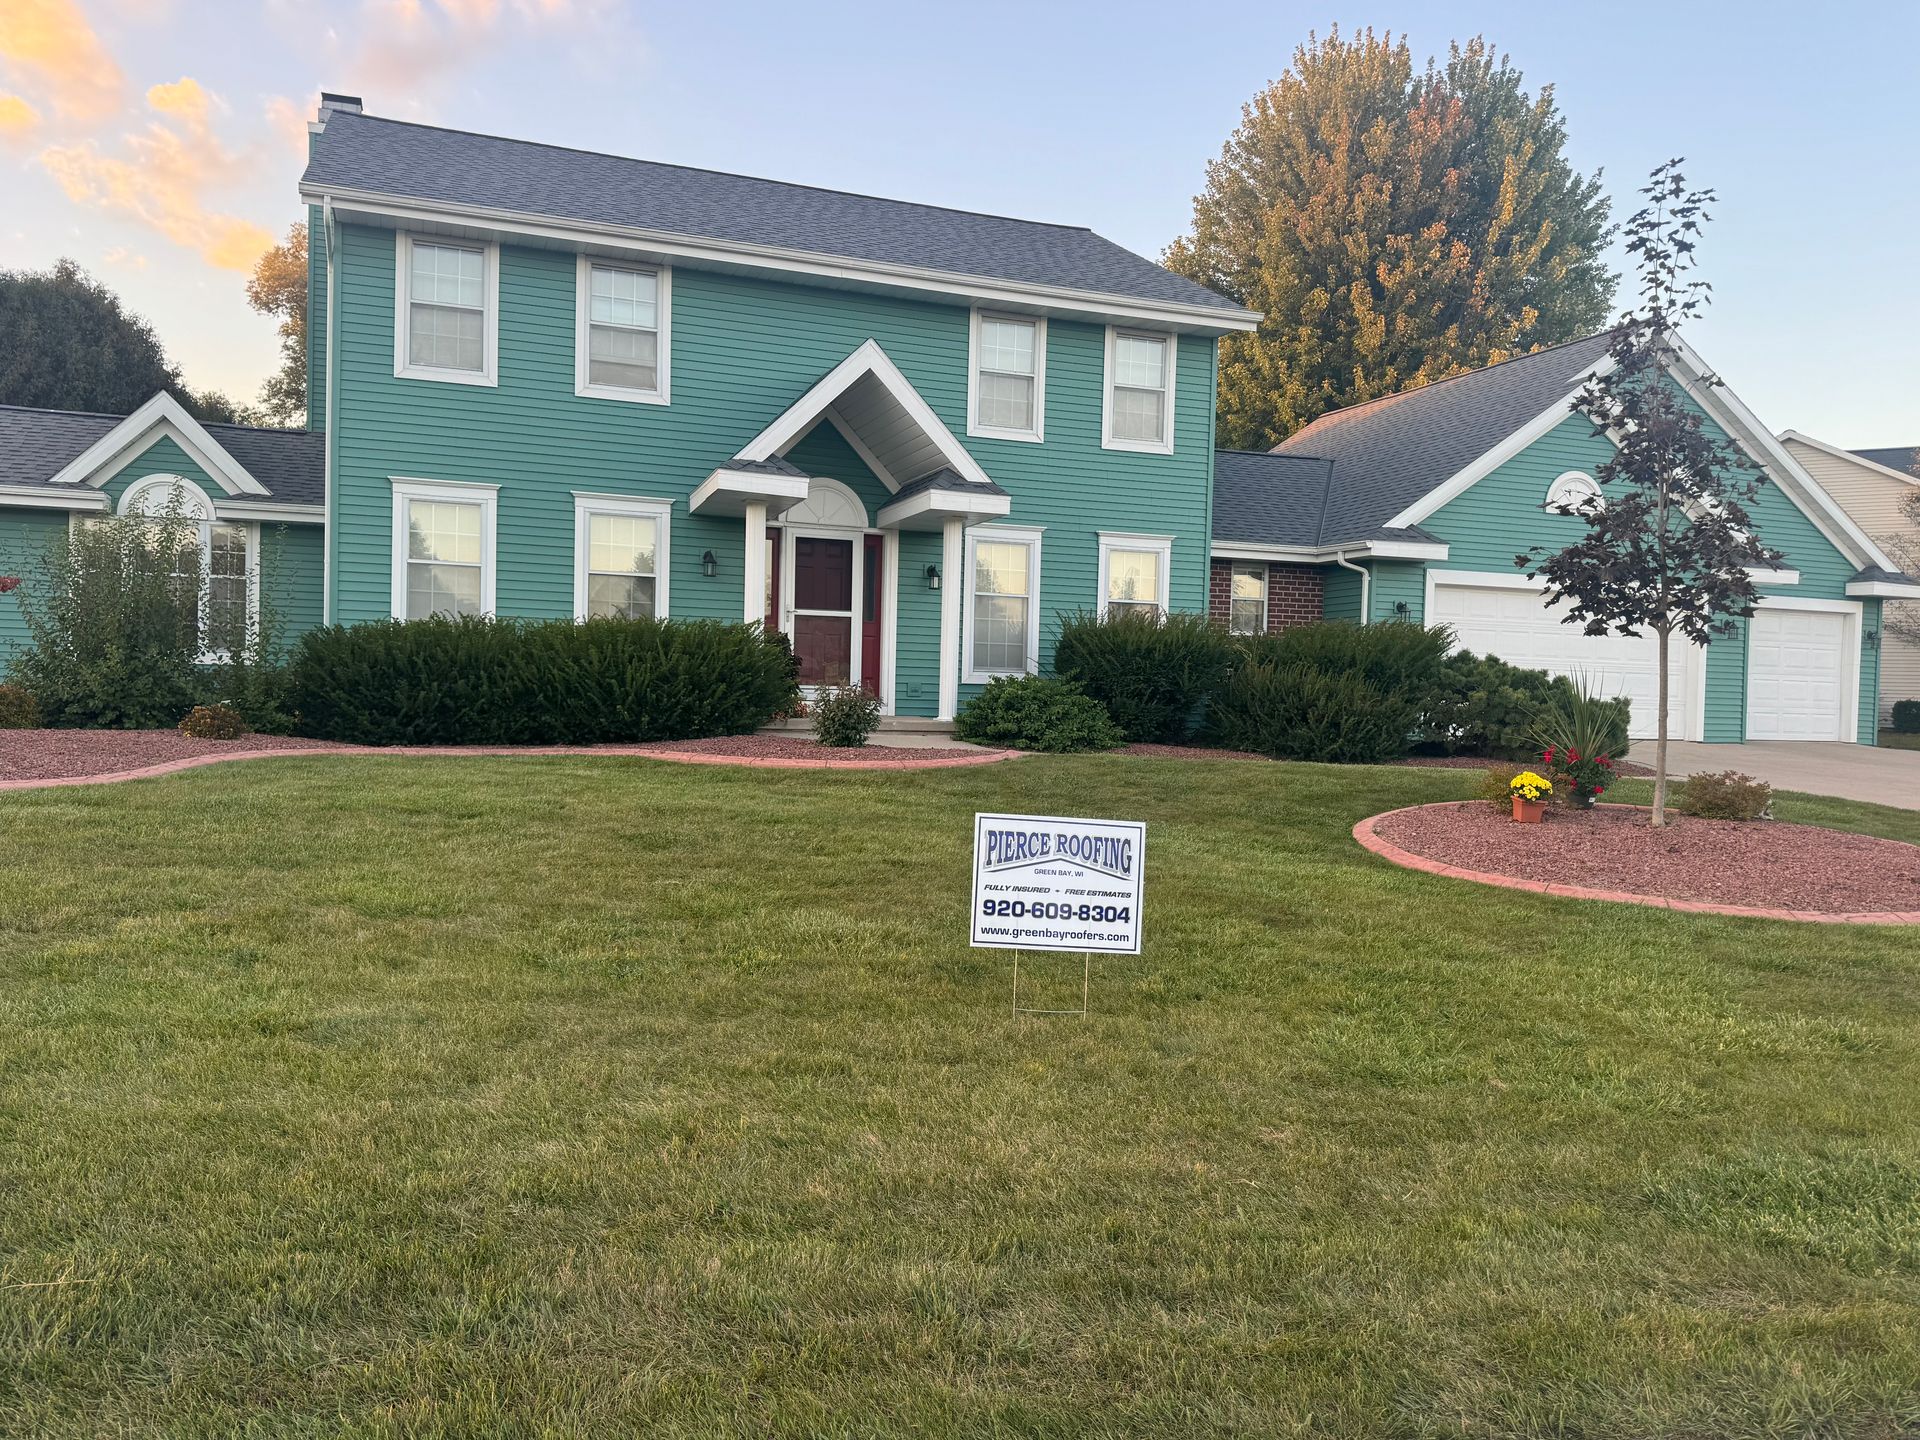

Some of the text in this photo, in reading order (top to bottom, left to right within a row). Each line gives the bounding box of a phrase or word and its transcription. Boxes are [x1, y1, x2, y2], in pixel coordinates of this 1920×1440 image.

[985, 829, 1132, 875] PIERCE ROOFING
[1034, 868, 1056, 876] GREEN
[984, 884, 1132, 899] FULLY INSURED FREE ESTIMATES
[983, 899, 1130, 923] 920-609-8304
[981, 926, 1129, 942] www.greenbayroofers.com
